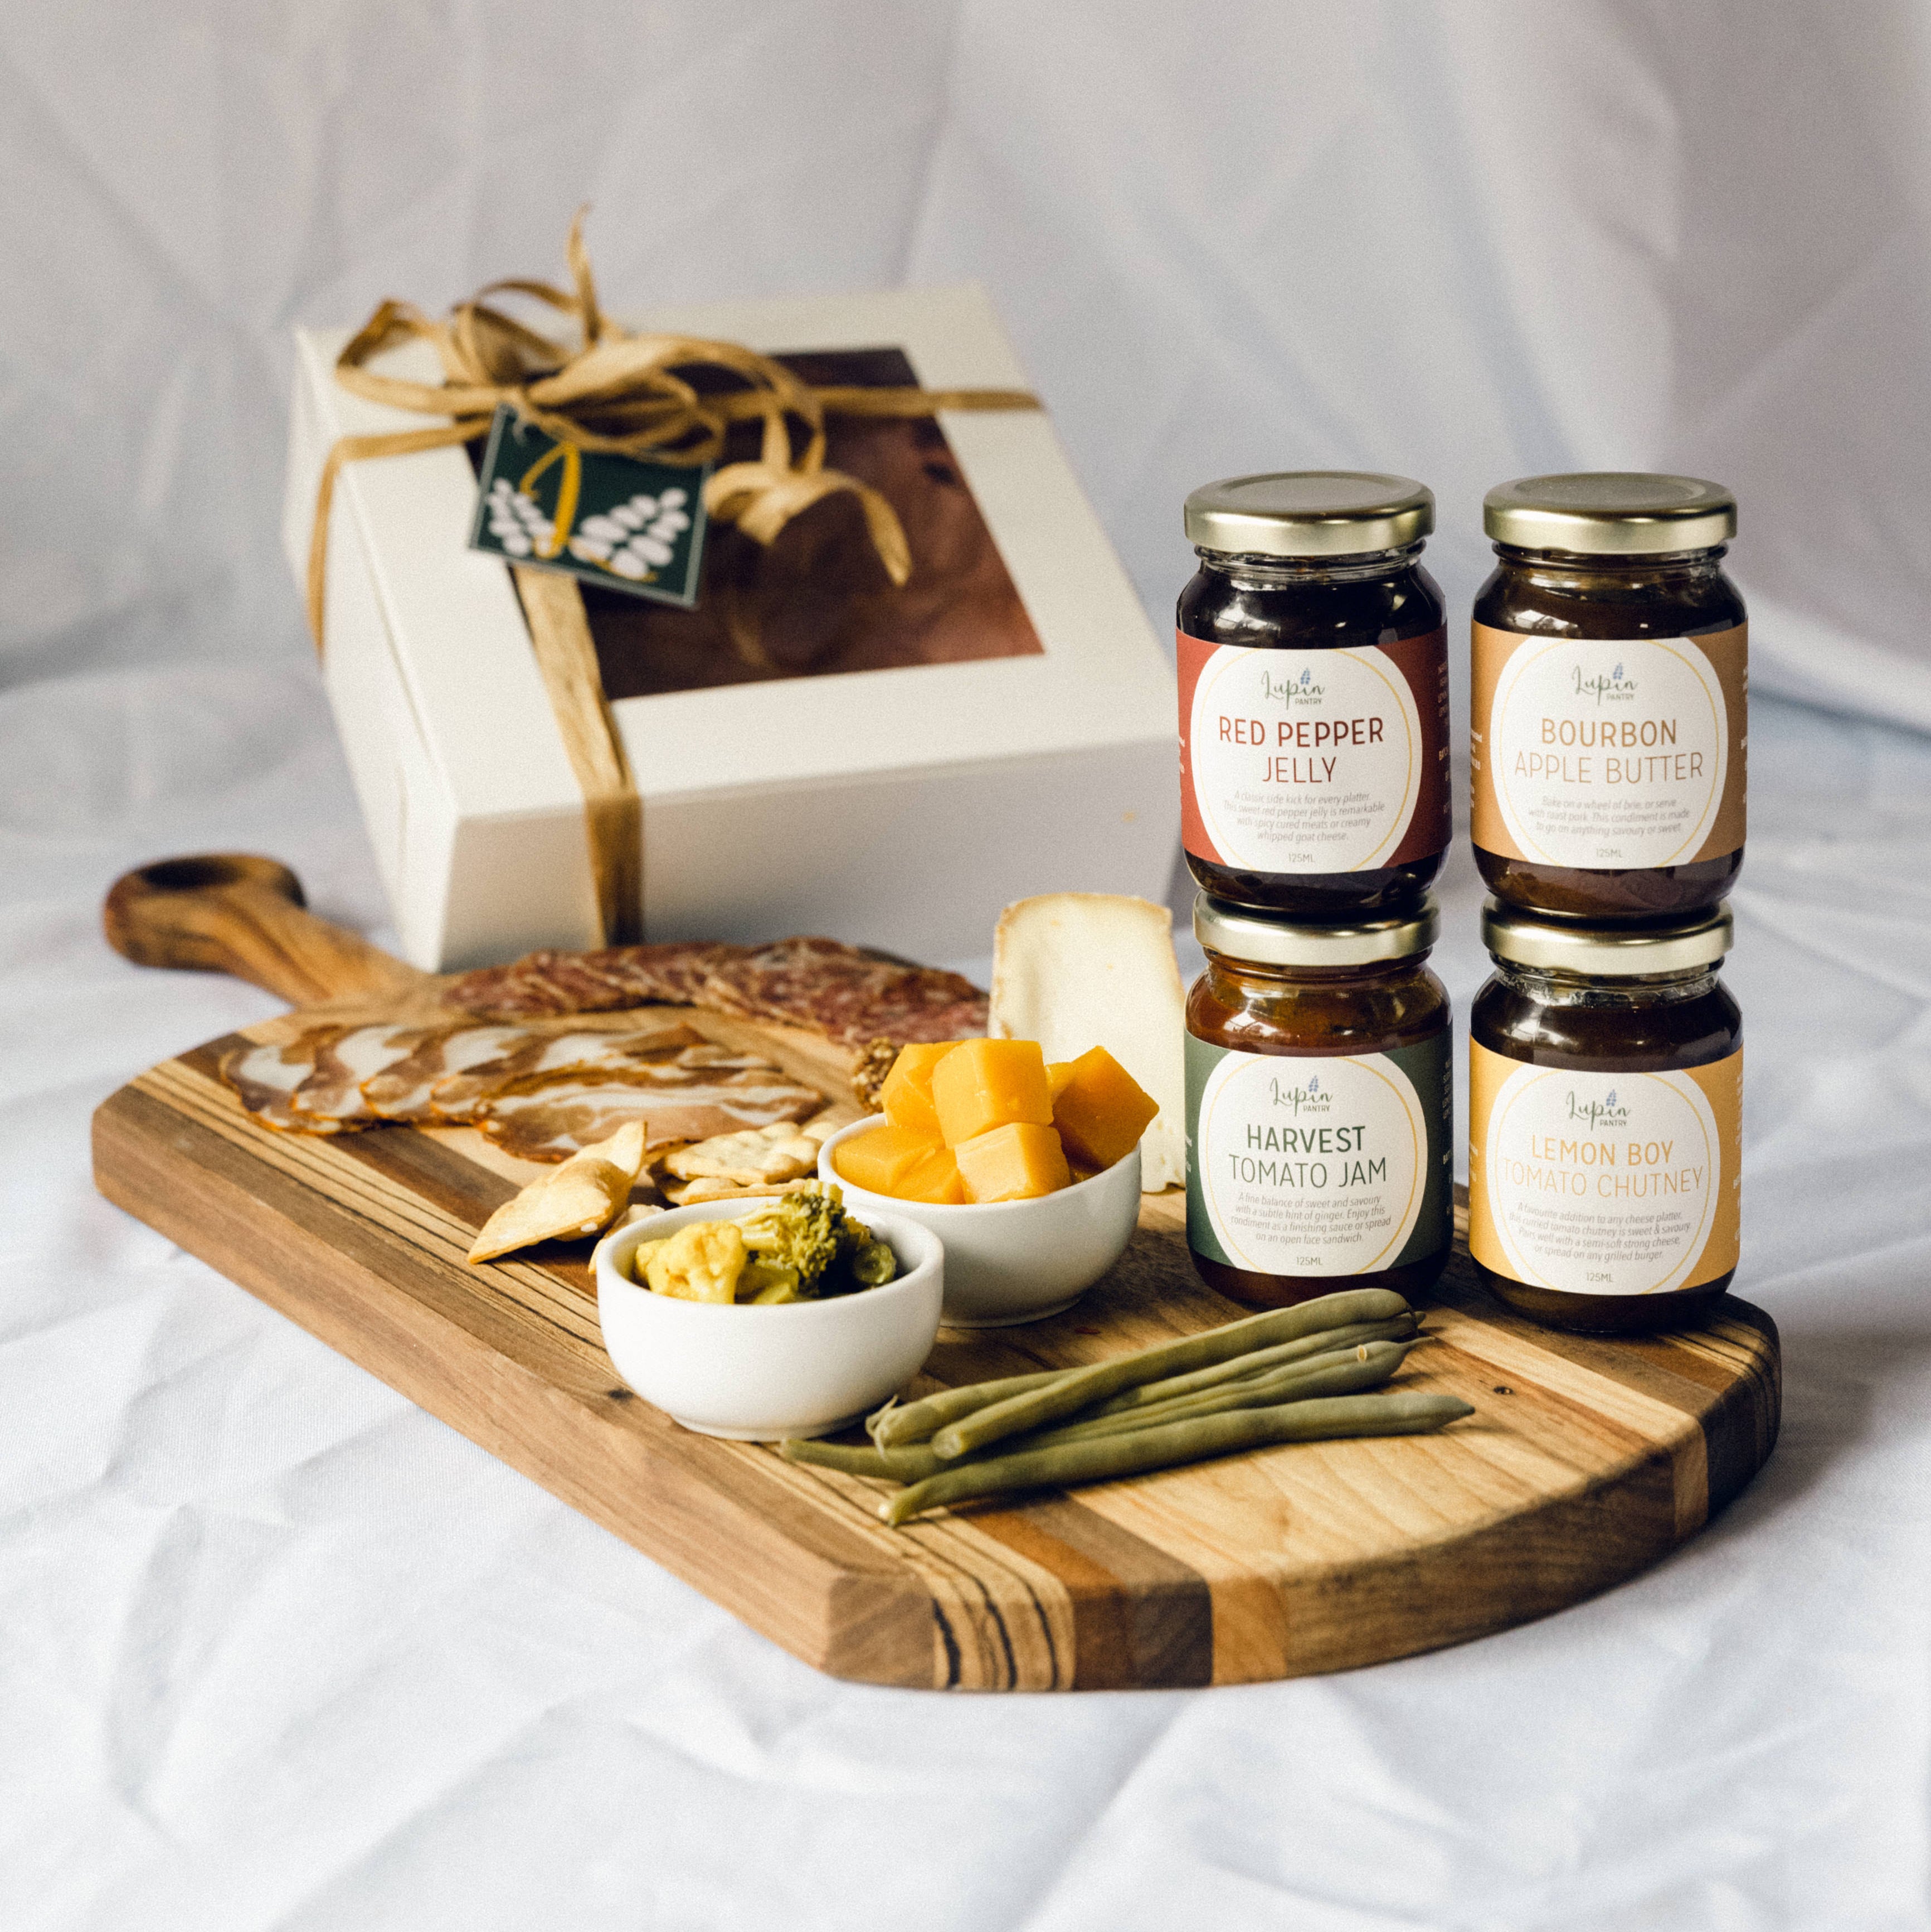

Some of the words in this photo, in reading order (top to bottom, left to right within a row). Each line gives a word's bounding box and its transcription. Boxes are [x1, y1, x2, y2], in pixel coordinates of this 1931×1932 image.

[1261, 669, 1325, 710] Lupin
[1572, 664, 1637, 705] Lupin
[1219, 716, 1265, 745] RED
[1278, 717, 1383, 747] PEPPER
[1542, 719, 1676, 748] BOURBON
[1262, 756, 1336, 783] JELLY
[1515, 752, 1592, 784] APPLE
[1607, 751, 1703, 784] BUTTER
[1234, 790, 1239, 799] A
[1267, 793, 1283, 803] side
[1286, 794, 1302, 804] kick
[1305, 794, 1316, 804] for
[1319, 797, 1341, 805] every
[1584, 800, 1611, 810] wheel
[1613, 798, 1622, 810] of
[1645, 801, 1655, 809] or
[1656, 799, 1676, 808] serve
[1224, 799, 1237, 812] This
[1239, 805, 1260, 814] sweet
[1262, 806, 1276, 816] red
[1277, 808, 1307, 819] pepper
[1309, 807, 1328, 819] jelly
[1330, 807, 1336, 816] is
[1339, 800, 1385, 815] remarkable
[1528, 808, 1545, 818] with
[1593, 812, 1609, 823] This
[1611, 812, 1657, 823] condiment
[1660, 811, 1666, 820] is
[1667, 807, 1690, 820] made
[1237, 816, 1252, 826] with
[1254, 819, 1275, 830] spicy
[1276, 819, 1300, 829] cured
[1302, 820, 1328, 829] meats
[1341, 818, 1371, 828] creamy
[1536, 821, 1544, 830] to
[1545, 824, 1556, 834] go
[1571, 826, 1609, 838] anything
[1613, 827, 1645, 837] savoury
[1647, 826, 1656, 834] or
[1258, 829, 1293, 842] whipped
[1296, 833, 1315, 844] goat
[1288, 853, 1315, 863] 125ML
[1596, 848, 1623, 858] 125ML
[1270, 1077, 1333, 1116] Lupin
[1566, 1090, 1631, 1130] Lupin
[1247, 1124, 1366, 1153] HARVEST
[1532, 1135, 1614, 1166] LEMON
[1628, 1140, 1674, 1166] BOY
[1229, 1154, 1327, 1188] TOMATO
[1339, 1157, 1386, 1187] JAM
[1502, 1158, 1587, 1196] TOMATO
[1598, 1166, 1704, 1198] CHUTNEY
[1238, 1192, 1243, 1201] A
[1245, 1193, 1259, 1203] fine
[1261, 1195, 1293, 1208] balance
[1295, 1198, 1304, 1208] of
[1305, 1200, 1330, 1208] sweet
[1332, 1197, 1349, 1208] and
[1350, 1196, 1381, 1207] savoury
[1236, 1205, 1251, 1215] with
[1259, 1208, 1283, 1219] subtle
[1285, 1209, 1302, 1220] hint
[1304, 1210, 1313, 1220] of
[1315, 1211, 1344, 1223] ginger.
[1347, 1208, 1369, 1221] Enjoy
[1371, 1204, 1386, 1216] this
[1517, 1202, 1523, 1211] A
[1524, 1203, 1558, 1219] favourite
[1559, 1211, 1594, 1223] addition
[1597, 1215, 1606, 1224] to
[1607, 1216, 1624, 1226] any
[1625, 1214, 1655, 1225] cheese
[1231, 1216, 1270, 1230] condiment
[1272, 1222, 1281, 1231] as
[1282, 1223, 1288, 1231] a
[1290, 1221, 1326, 1234] finishing
[1329, 1223, 1353, 1232] sauce
[1355, 1222, 1363, 1230] or
[1364, 1215, 1392, 1231] spread
[1509, 1212, 1521, 1223] this
[1523, 1217, 1549, 1230] curried
[1550, 1223, 1580, 1235] tomato
[1582, 1225, 1617, 1239] chutney
[1619, 1226, 1626, 1236] is
[1628, 1226, 1652, 1236] sweet
[1653, 1223, 1660, 1235] &
[1256, 1232, 1266, 1241] on
[1268, 1234, 1278, 1242] an
[1280, 1235, 1301, 1246] open
[1303, 1234, 1321, 1244] face
[1519, 1226, 1535, 1240] Pairs
[1538, 1232, 1554, 1243] well
[1555, 1235, 1573, 1246] with
[1583, 1238, 1622, 1249] semi-soft
[1624, 1239, 1651, 1251] strong
[1296, 1256, 1322, 1266] 125ML
[1534, 1244, 1543, 1252] or
[1544, 1246, 1572, 1258] spread
[1573, 1250, 1585, 1259] on
[1587, 1251, 1603, 1262] any
[1604, 1251, 1633, 1264] grilled
[1586, 1271, 1613, 1283] 125ML
